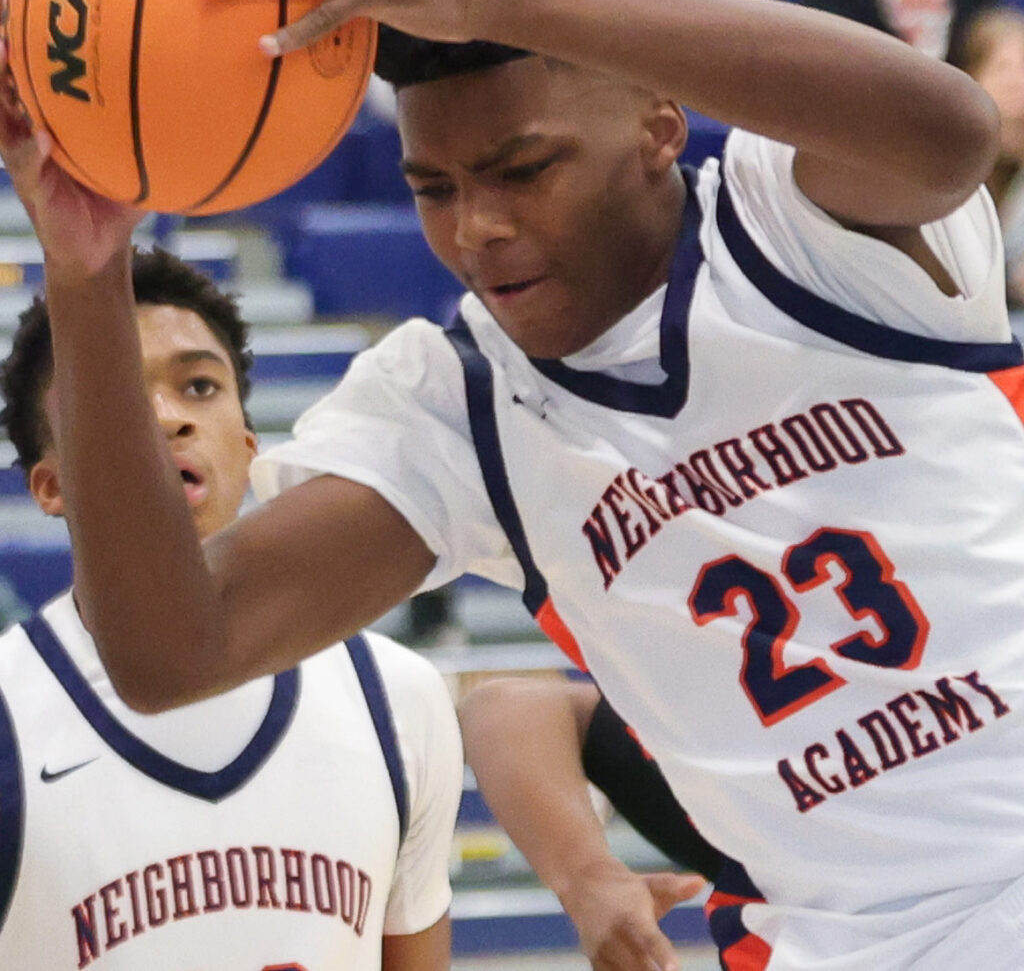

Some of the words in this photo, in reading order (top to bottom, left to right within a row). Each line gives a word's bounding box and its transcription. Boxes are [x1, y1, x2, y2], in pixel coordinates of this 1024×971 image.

[687, 526, 930, 728] 23
[777, 670, 1010, 813] ACADEMY
[71, 845, 372, 970] NEIGHBORHOOD
